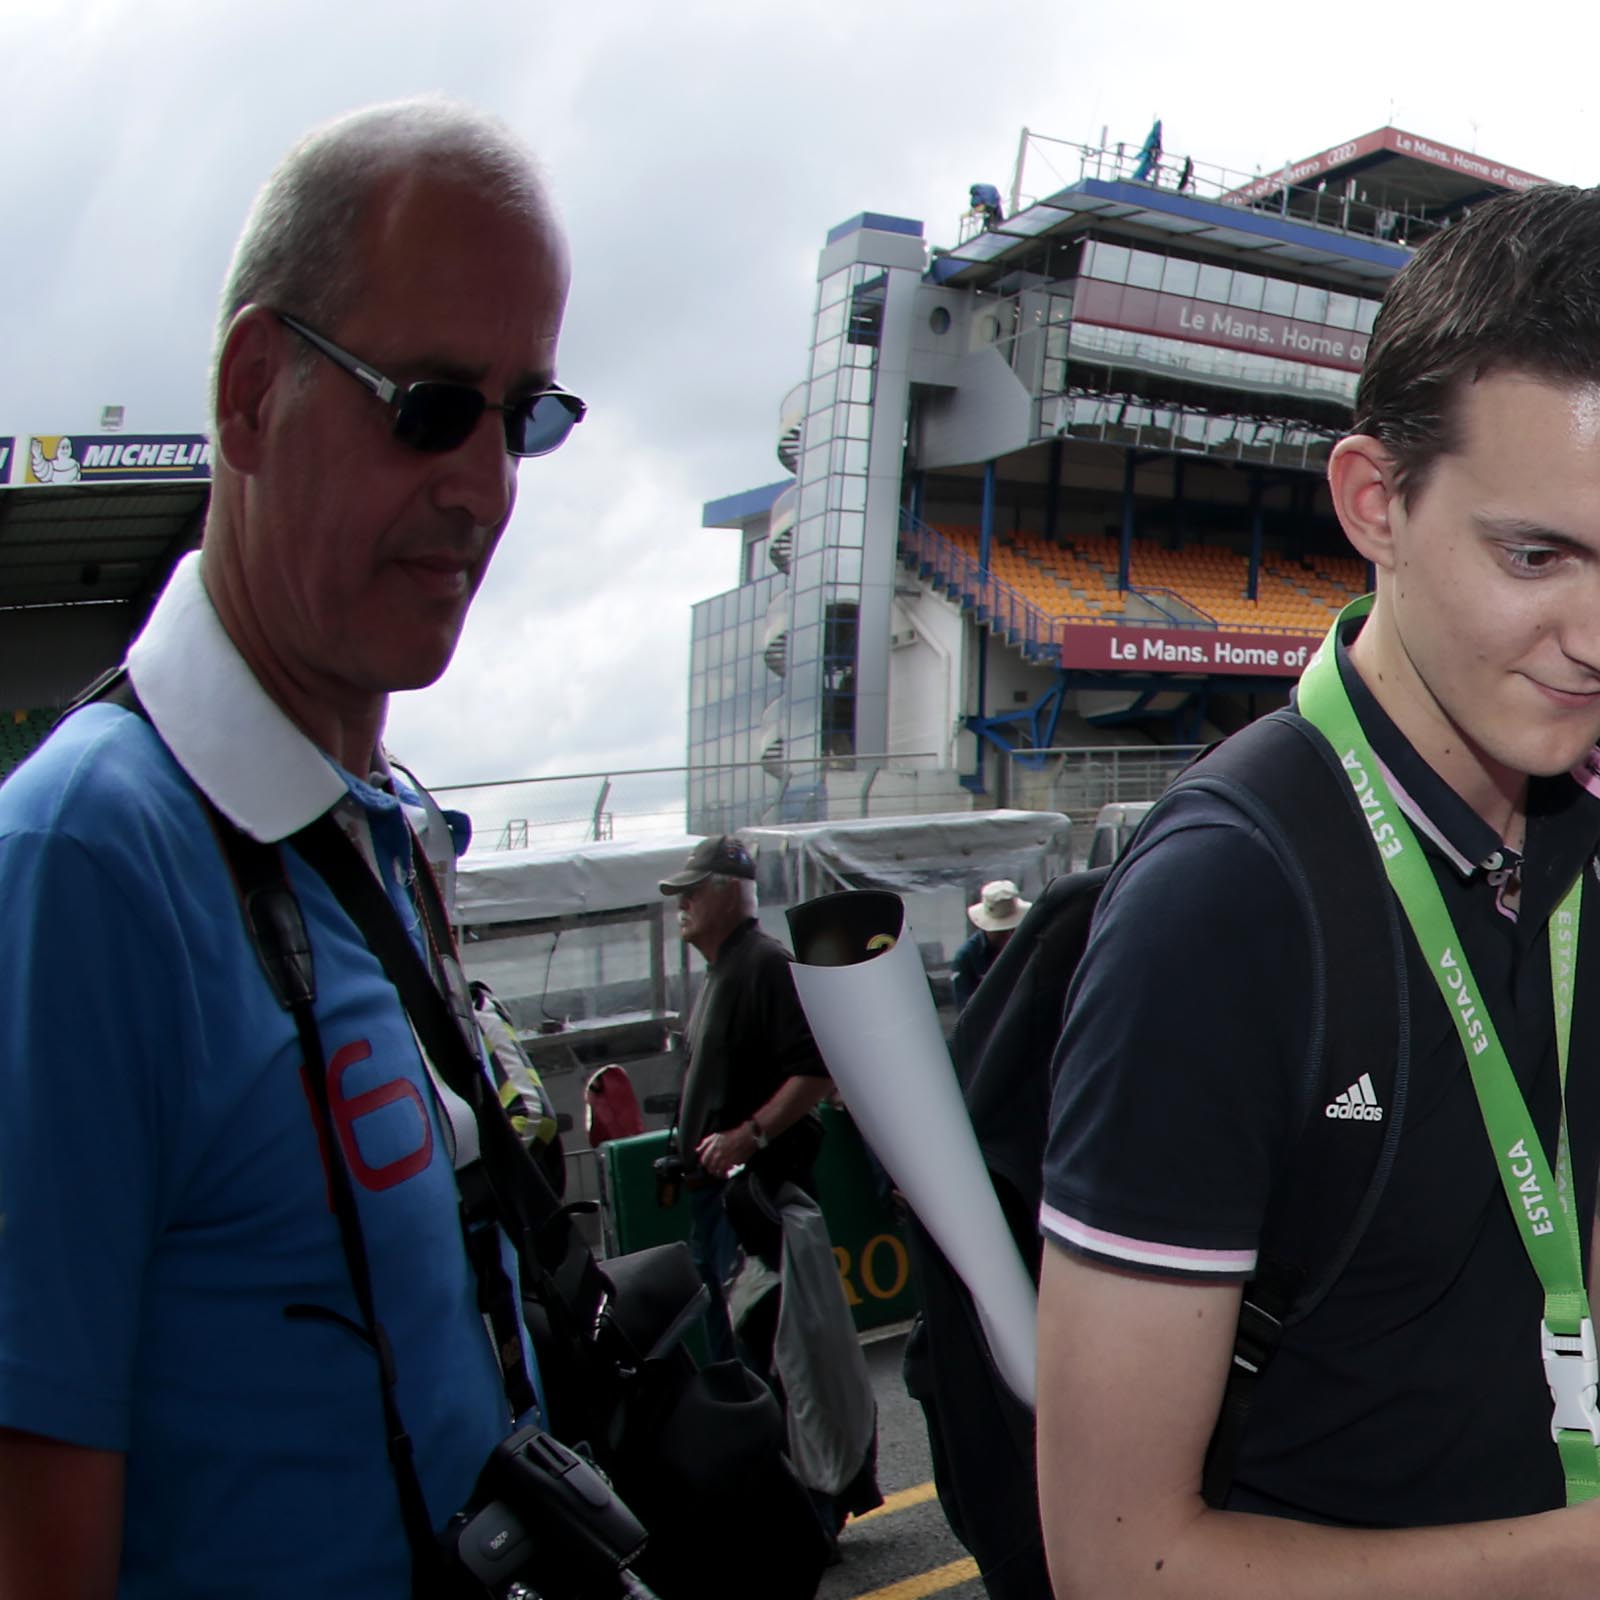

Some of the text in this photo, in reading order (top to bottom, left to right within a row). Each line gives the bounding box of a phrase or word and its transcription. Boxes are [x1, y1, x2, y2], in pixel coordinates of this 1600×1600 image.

[1396, 135, 1411, 150] Le
[1453, 152, 1489, 176] Home
[1180, 307, 1205, 329] Le
[1211, 313, 1274, 344] Mans.
[1281, 327, 1343, 359] Home
[1110, 637, 1307, 666] Le Mans. Home of
[1340, 749, 1404, 859] ESTACA
[1440, 947, 1490, 1056] ESTACA
[1326, 1100, 1382, 1122] adidas
[1508, 1139, 1554, 1236] ESTACA
